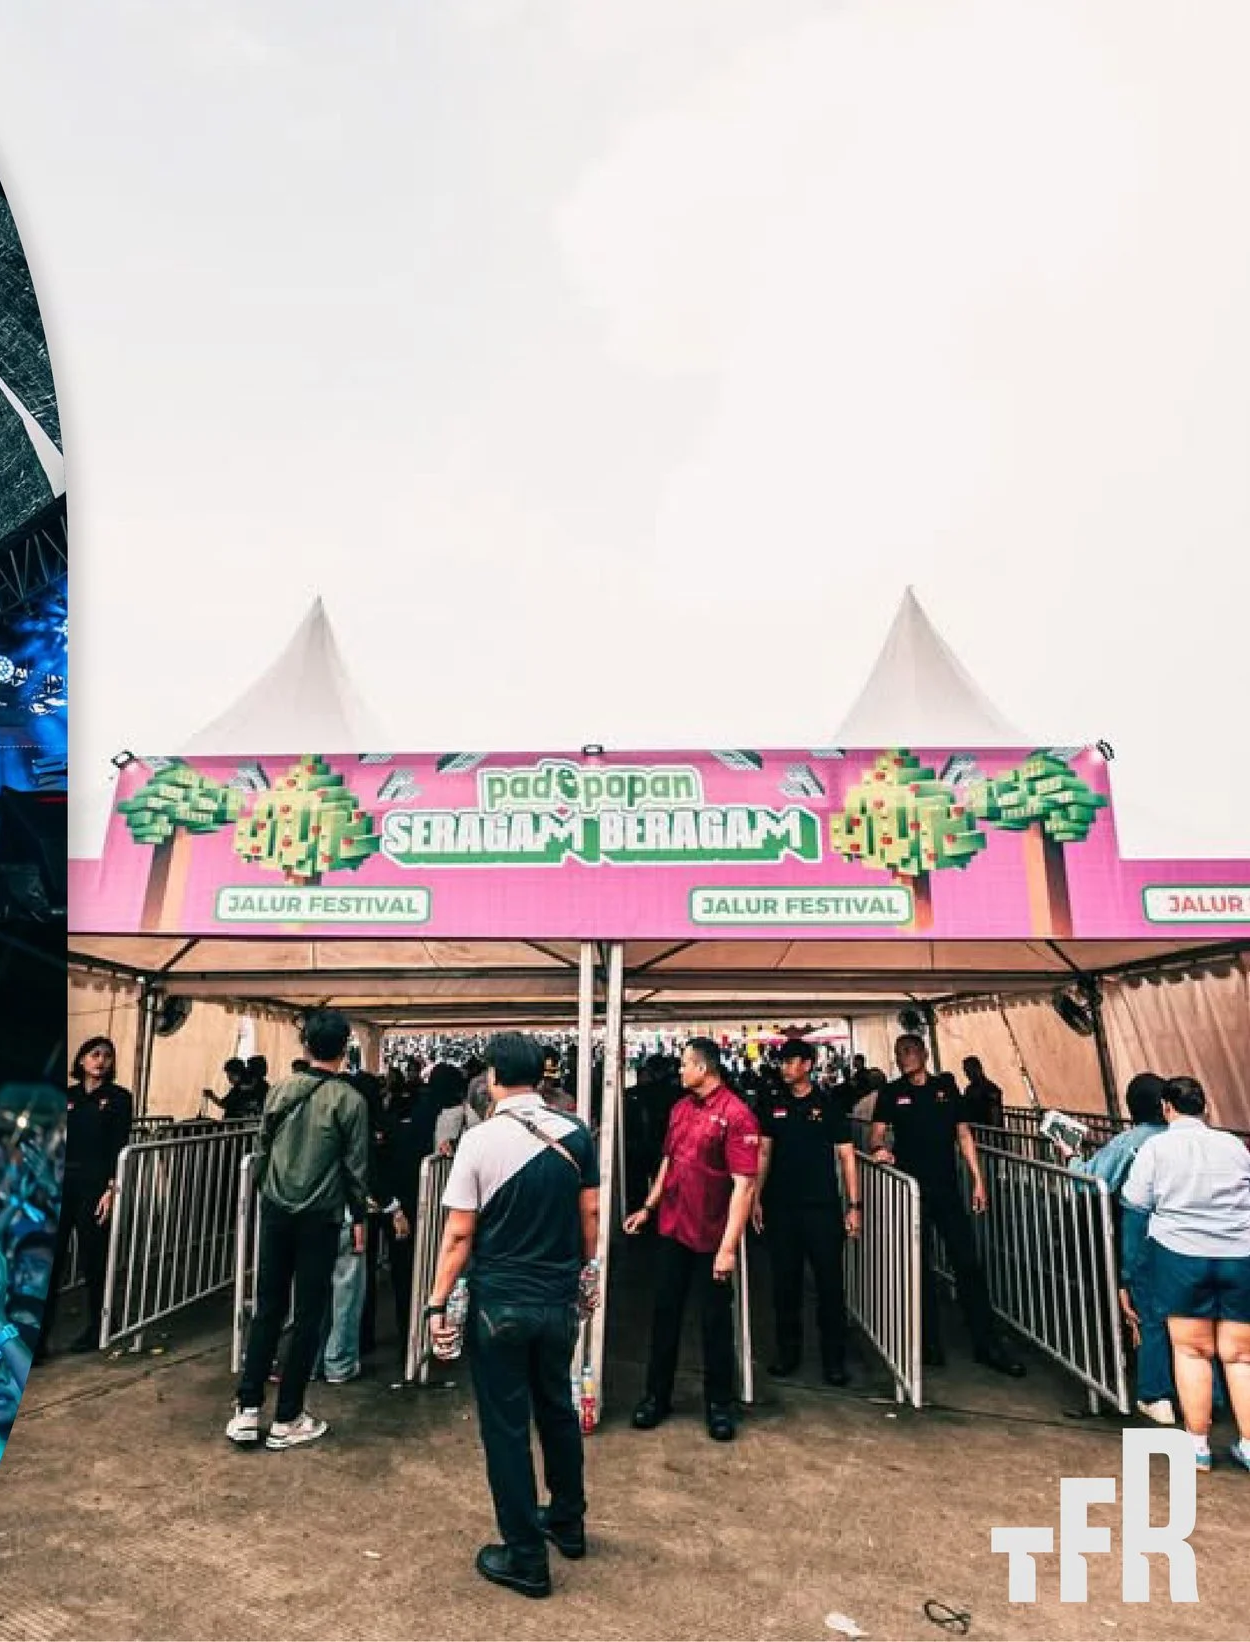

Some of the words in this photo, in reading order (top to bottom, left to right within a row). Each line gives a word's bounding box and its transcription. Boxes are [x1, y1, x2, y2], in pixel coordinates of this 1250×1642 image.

[384, 809, 582, 853] SERAGAM
[599, 808, 802, 852] BERAGAM
[228, 894, 301, 913] JALUR
[309, 896, 419, 914] FESTIVAL
[702, 896, 778, 915] JALUR
[785, 896, 900, 915] FESTIVAL
[1167, 894, 1245, 913] JALUR
